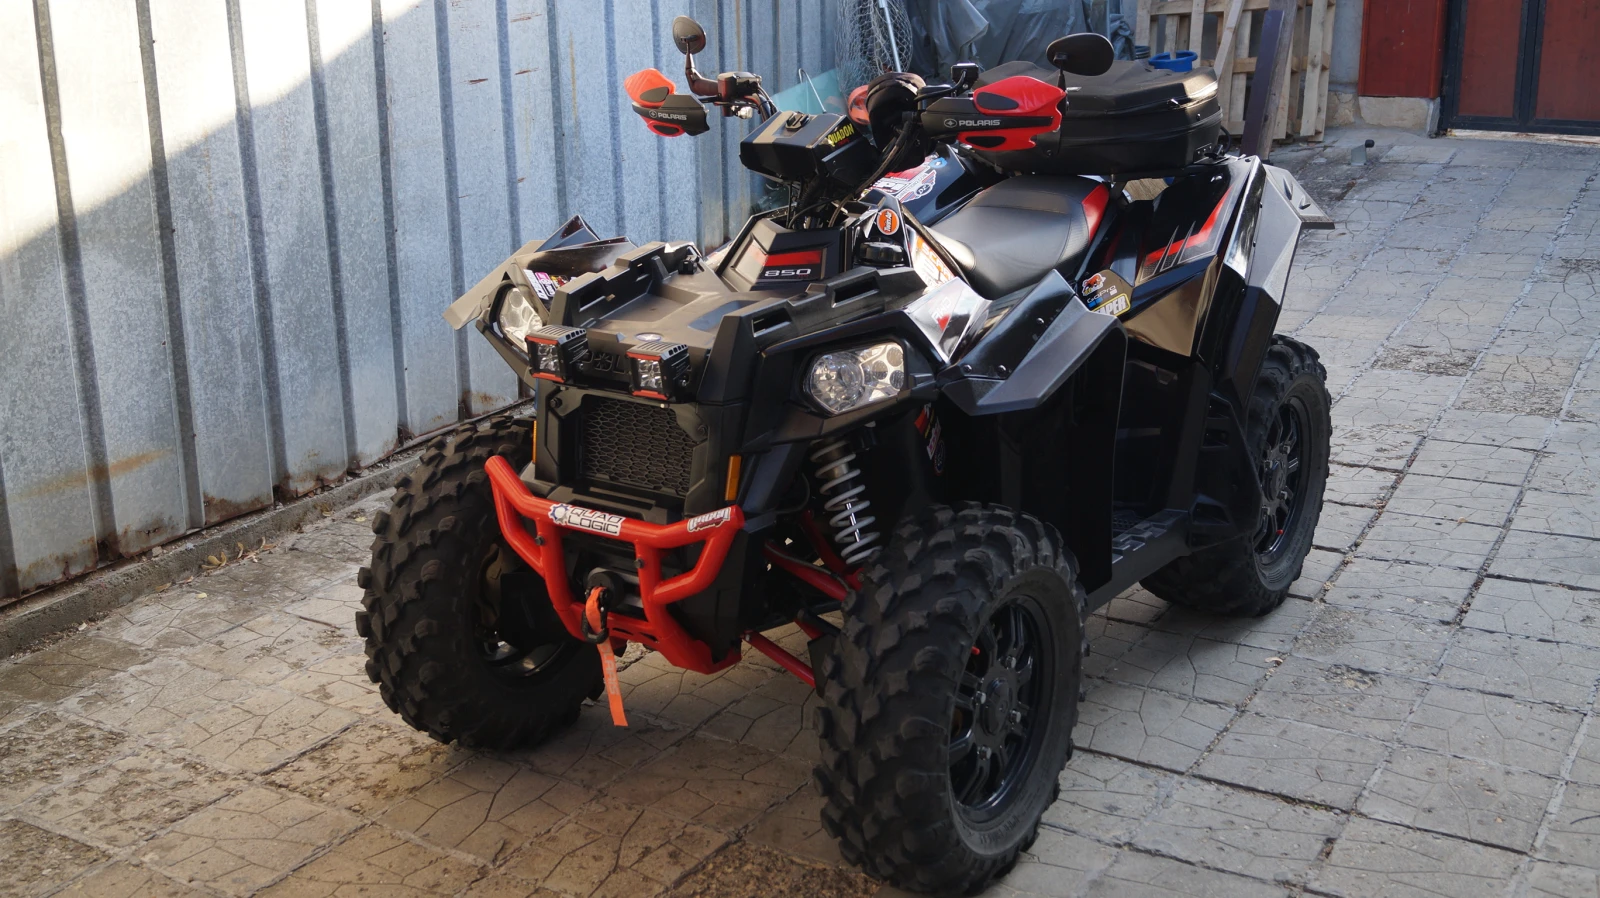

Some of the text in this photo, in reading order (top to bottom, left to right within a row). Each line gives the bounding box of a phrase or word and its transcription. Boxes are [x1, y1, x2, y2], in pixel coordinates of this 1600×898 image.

[658, 112, 688, 121] POLARIS
[958, 119, 1001, 127] POLARIS
[827, 123, 855, 147] QUADON
[764, 268, 812, 277] 850
[1086, 285, 1116, 304] GoPro
[1096, 295, 1126, 315] APER
[567, 515, 619, 534] LOGIC
[570, 507, 625, 524] QUAD
